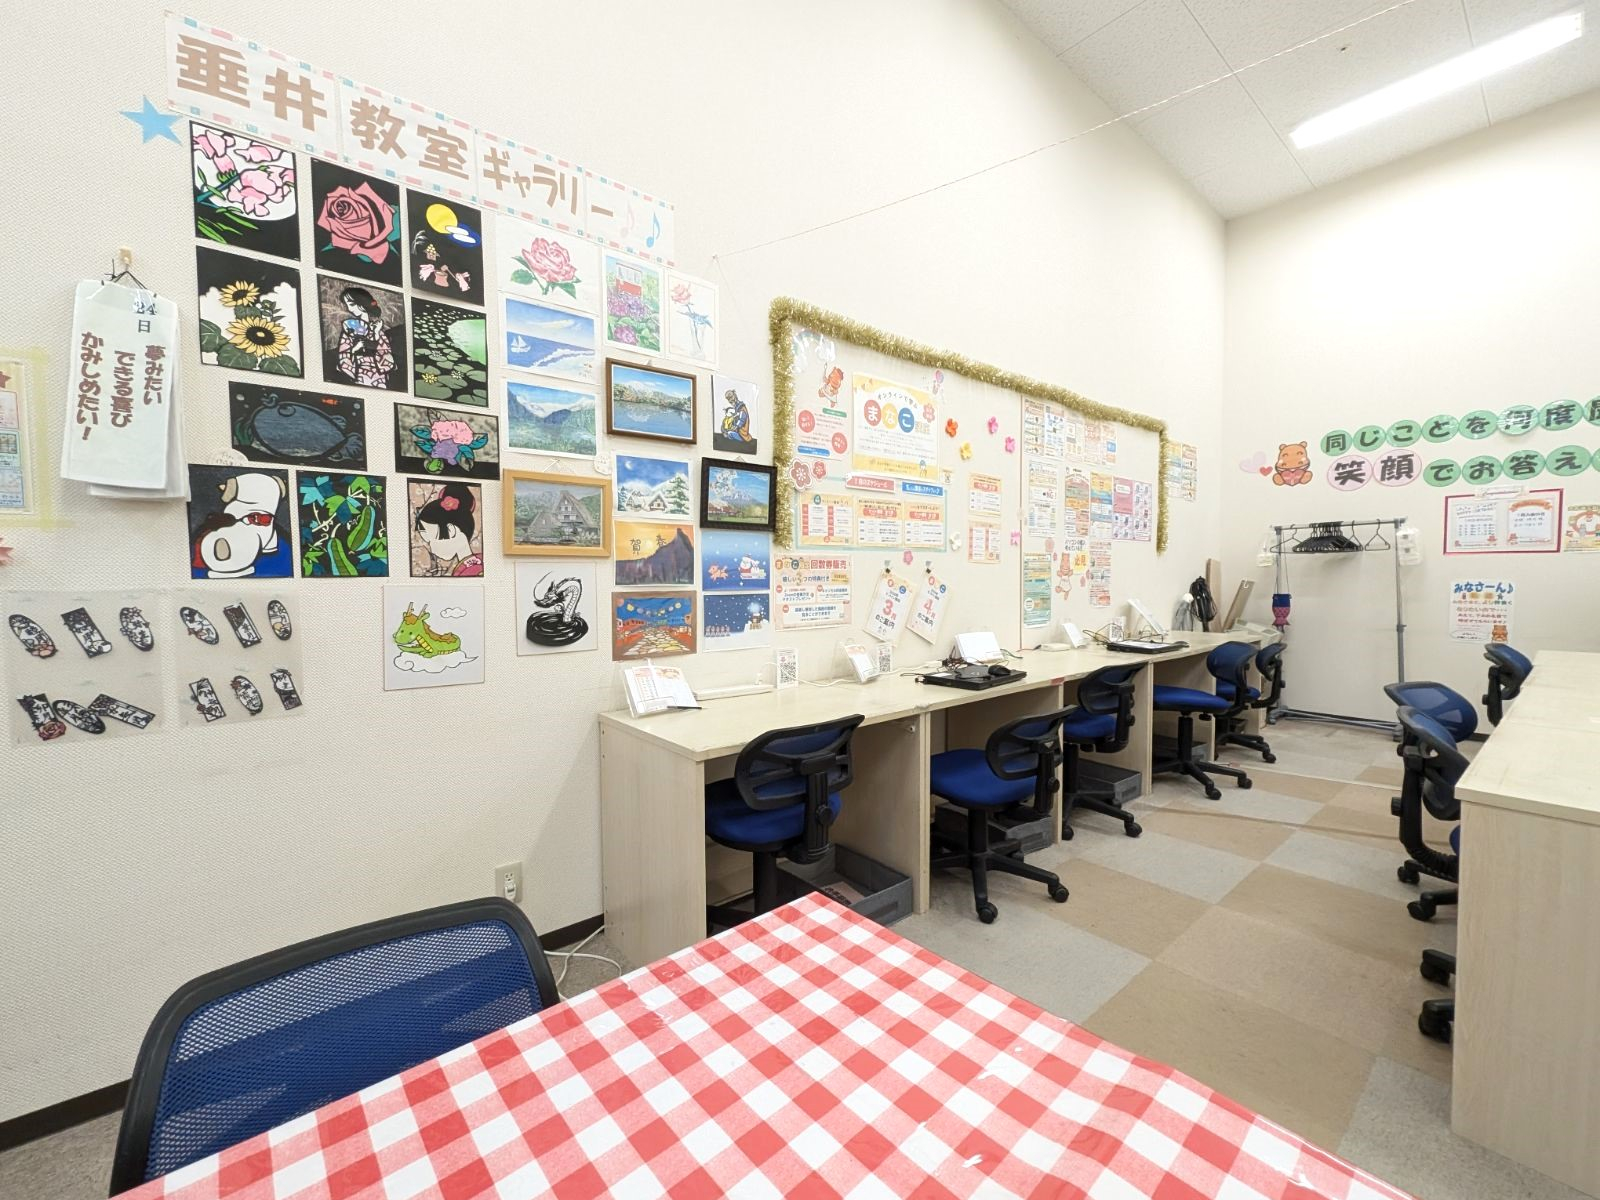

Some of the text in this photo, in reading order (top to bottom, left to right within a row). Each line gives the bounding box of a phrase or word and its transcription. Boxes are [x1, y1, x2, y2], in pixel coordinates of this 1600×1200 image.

[76, 331, 104, 441] かみしめたい!
[110, 350, 136, 428] できる喜び
[143, 344, 166, 405] 夢みたい
[866, 405, 912, 428] まなこ
